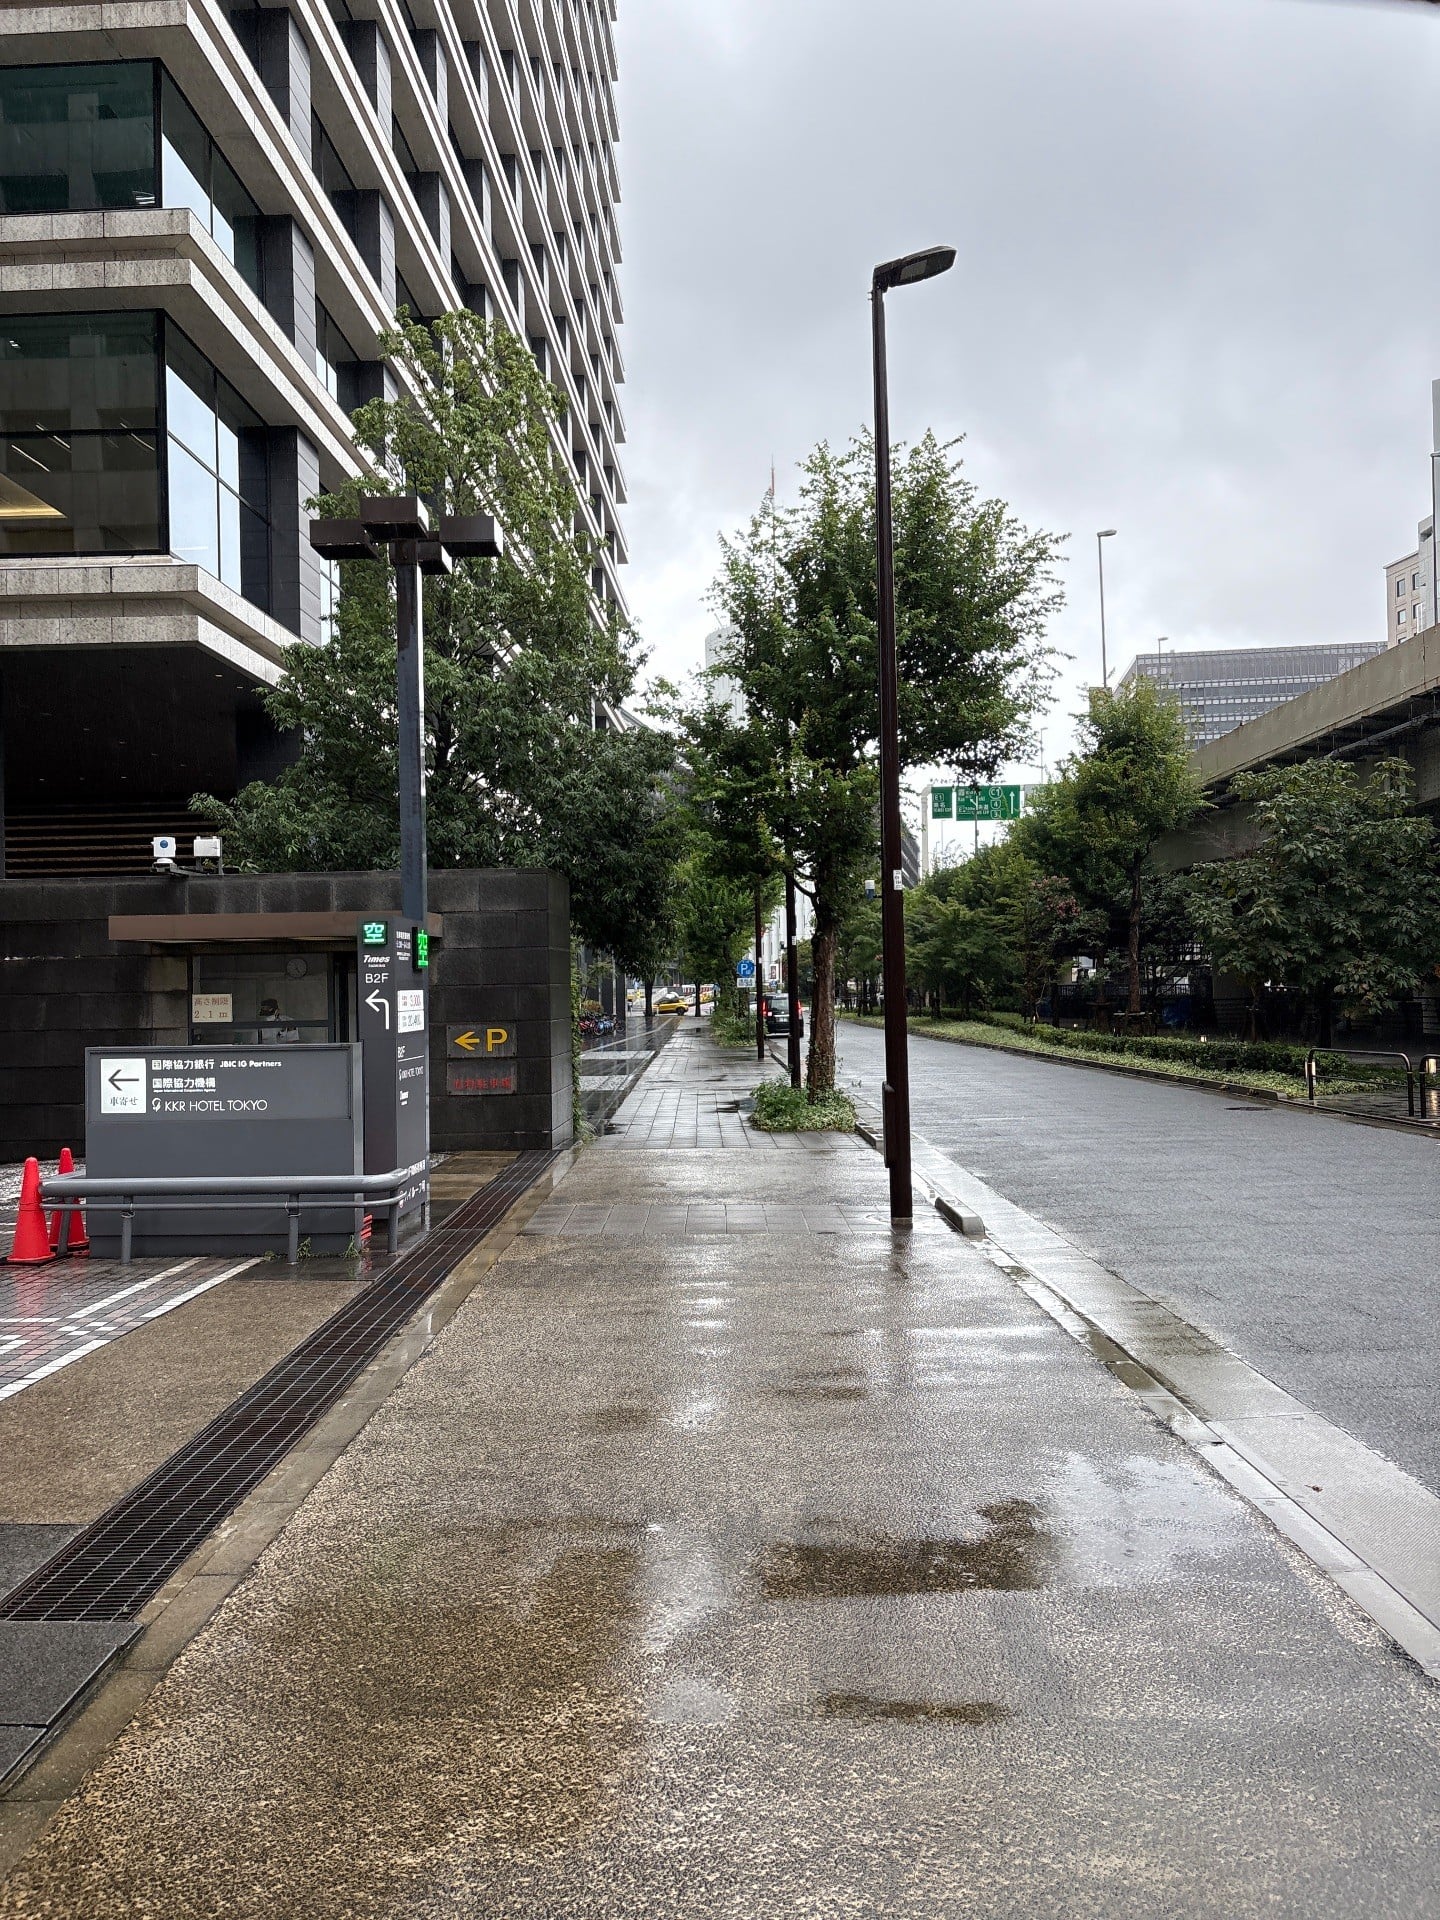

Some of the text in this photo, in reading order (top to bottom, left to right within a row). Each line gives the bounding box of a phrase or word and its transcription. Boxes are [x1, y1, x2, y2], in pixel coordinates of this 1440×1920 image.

[363, 922, 386, 943] 空
[417, 929, 429, 968] 空
[363, 954, 391, 964] Times
[365, 972, 389, 984] B2F
[194, 996, 229, 1006] 高さ制限
[486, 1028, 509, 1052] P
[151, 1059, 215, 1071] 国際協力銀行
[219, 1060, 237, 1068] JBIC
[249, 1060, 282, 1068] Partners
[152, 1077, 216, 1089] 国際協力機構
[109, 1096, 139, 1107] 車寄せ
[164, 1099, 268, 1112] KKR HOTEL TOKYO
